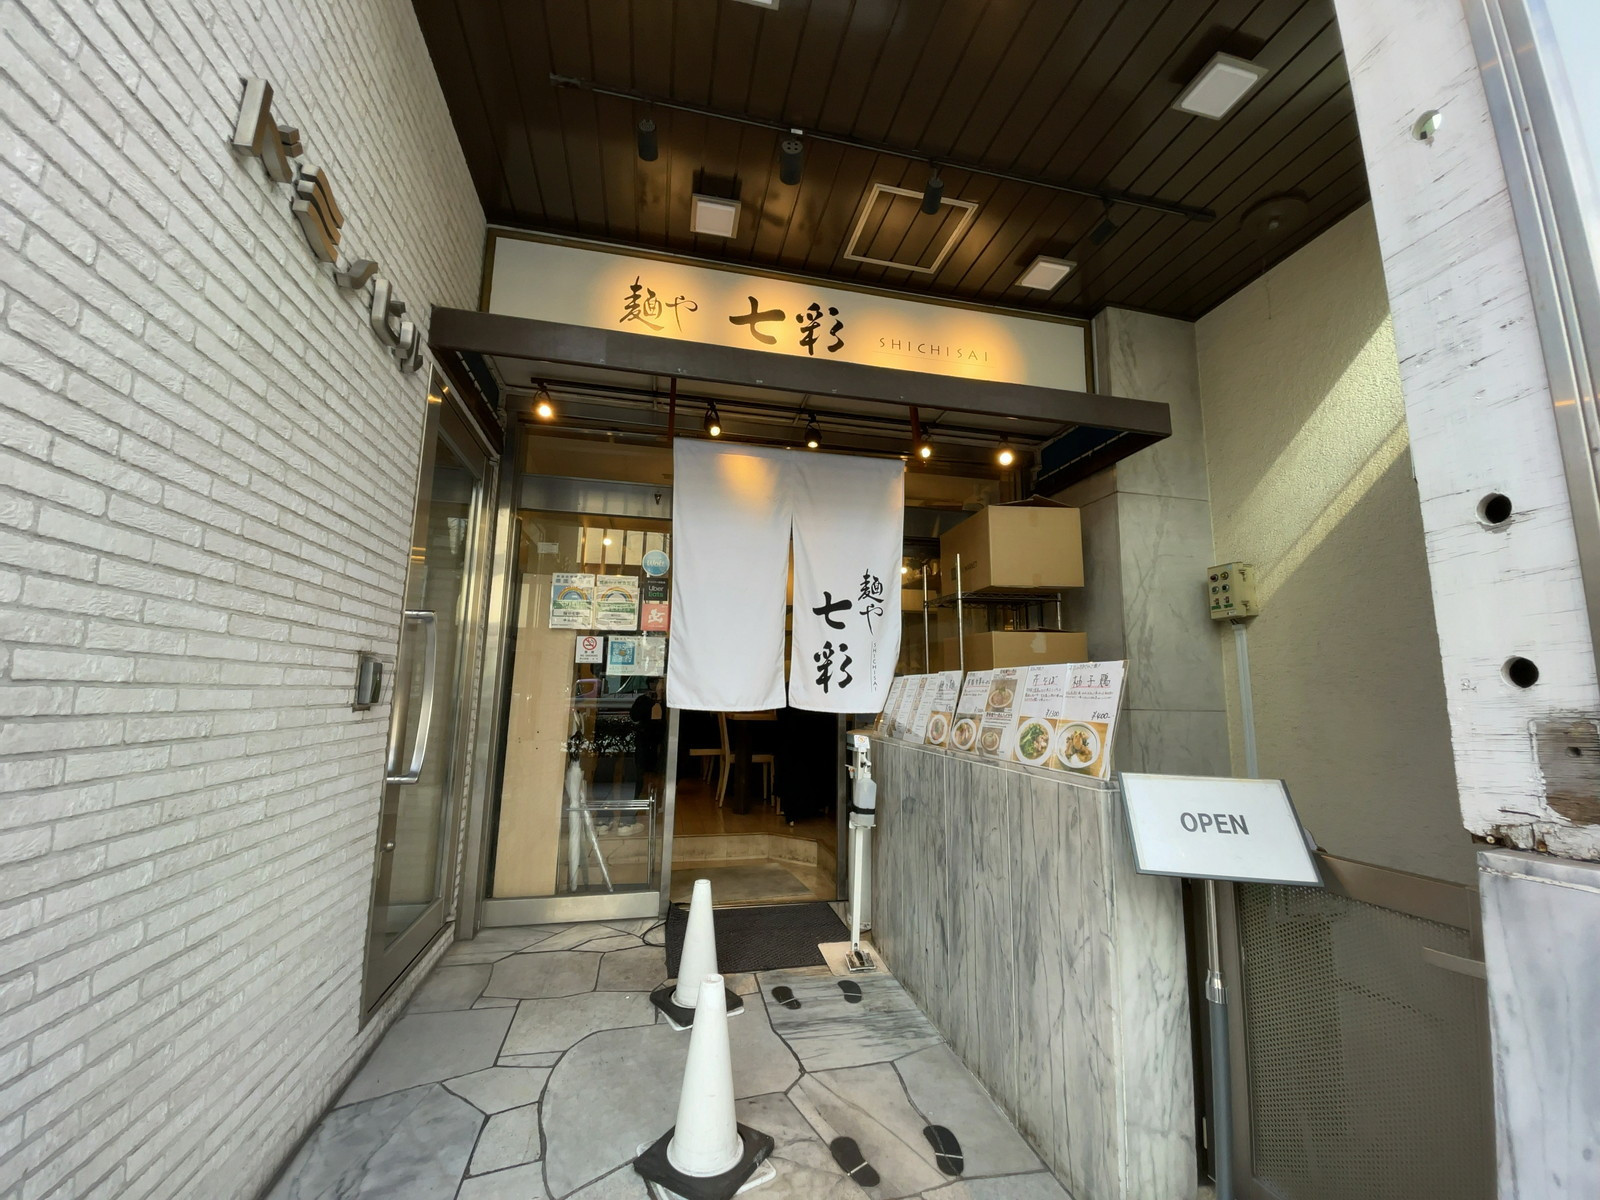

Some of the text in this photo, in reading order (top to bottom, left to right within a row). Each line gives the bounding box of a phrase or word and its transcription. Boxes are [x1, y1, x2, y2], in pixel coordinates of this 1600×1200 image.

[729, 296, 844, 356] 七彩
[879, 337, 989, 362] SHICHISAI
[812, 591, 853, 694] 七彩
[1180, 812, 1250, 835] OPEN
